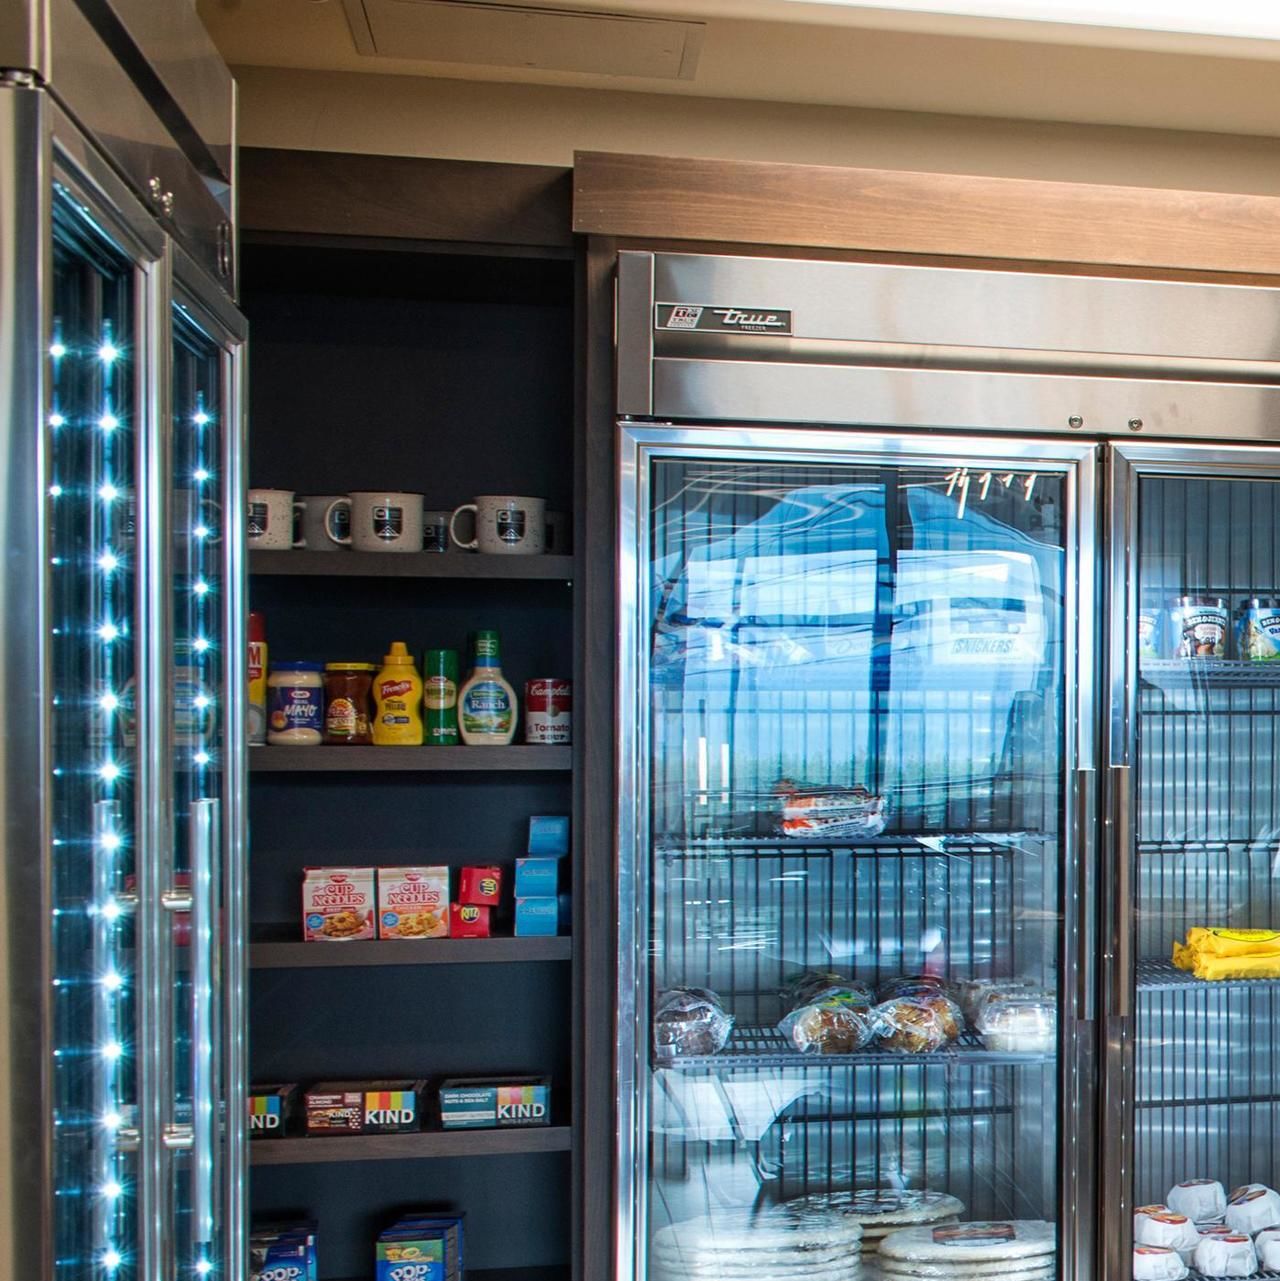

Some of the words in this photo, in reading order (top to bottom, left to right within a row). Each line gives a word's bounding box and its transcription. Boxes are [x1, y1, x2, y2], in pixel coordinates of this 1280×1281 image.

[284, 704, 318, 717] MAYO
[471, 700, 506, 710] Ranch
[534, 723, 569, 732] Tomato
[325, 883, 354, 894] CUP
[401, 883, 429, 893] CUP
[312, 893, 366, 907] NOODLES
[388, 892, 440, 905] NOODLES
[365, 1110, 415, 1125] KIND
[497, 1104, 545, 1119] KIND
[250, 1114, 280, 1129] ND
